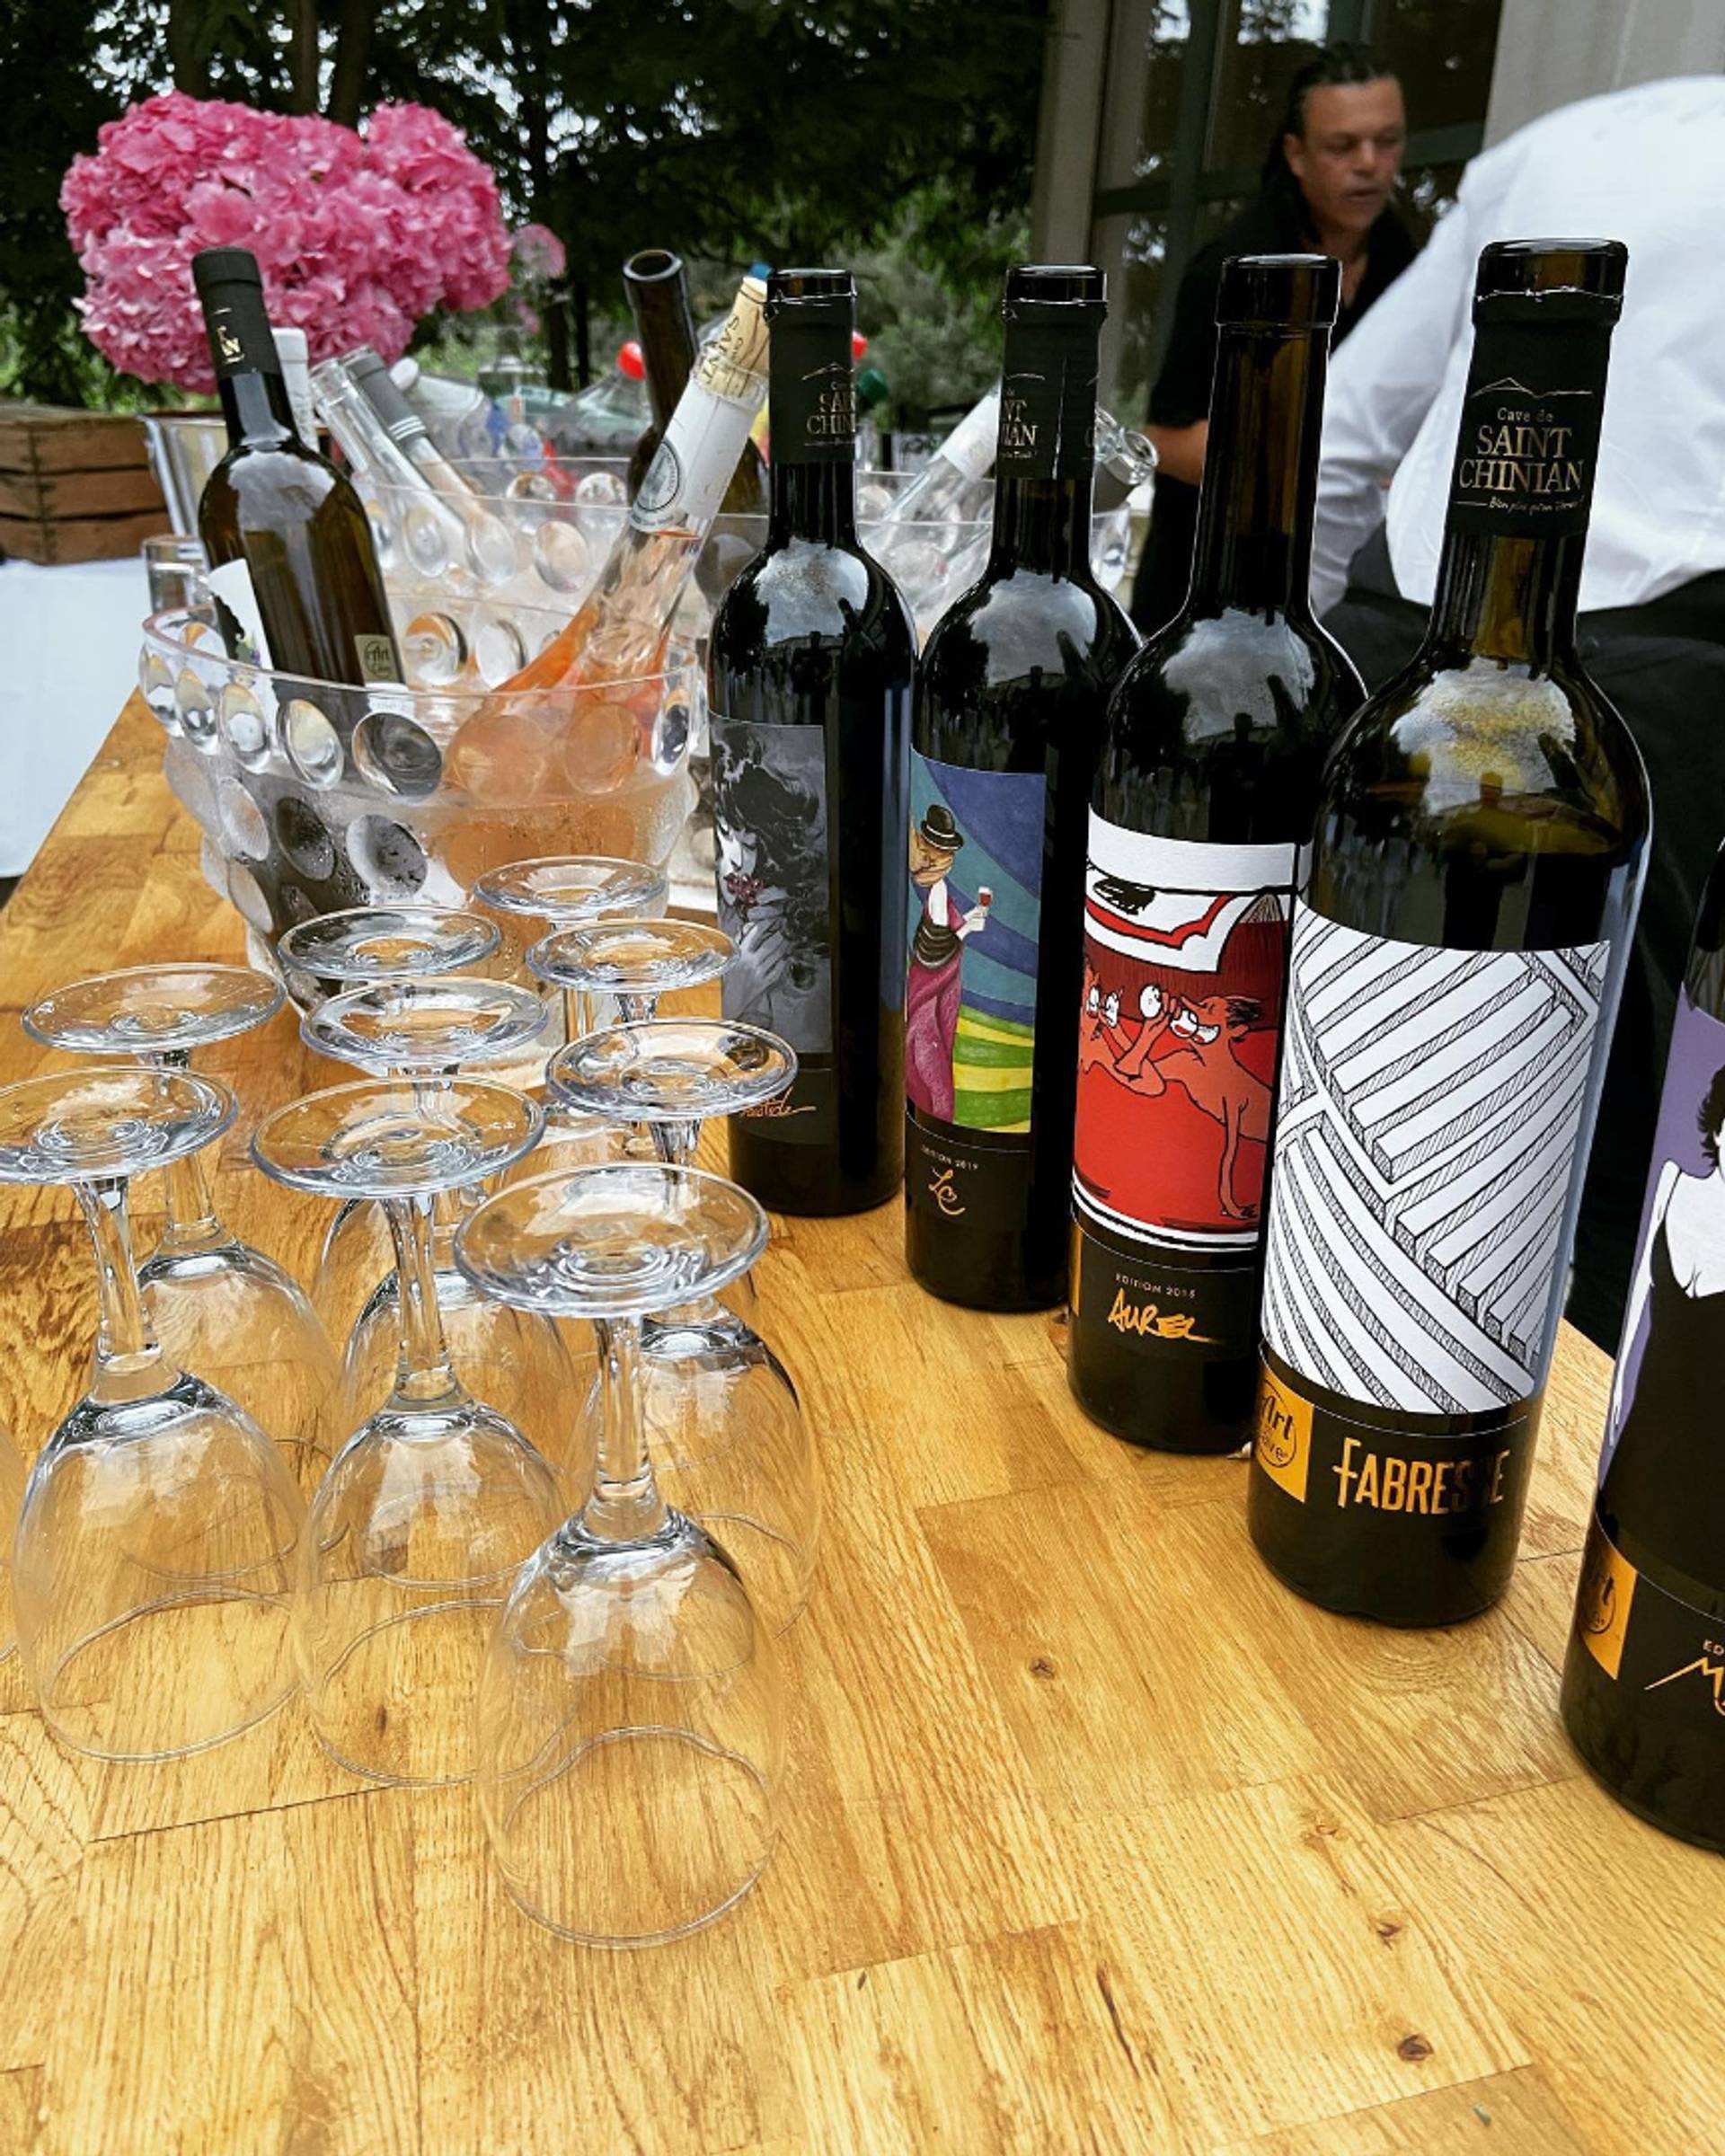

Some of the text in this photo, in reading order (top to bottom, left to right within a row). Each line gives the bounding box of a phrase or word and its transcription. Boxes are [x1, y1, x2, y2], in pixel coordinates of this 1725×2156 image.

[1497, 407, 1531, 421] Cave
[1476, 424, 1572, 459] SAINT
[1459, 458, 1584, 494] CHINIAN
[1115, 1272, 1162, 1294] EDITION
